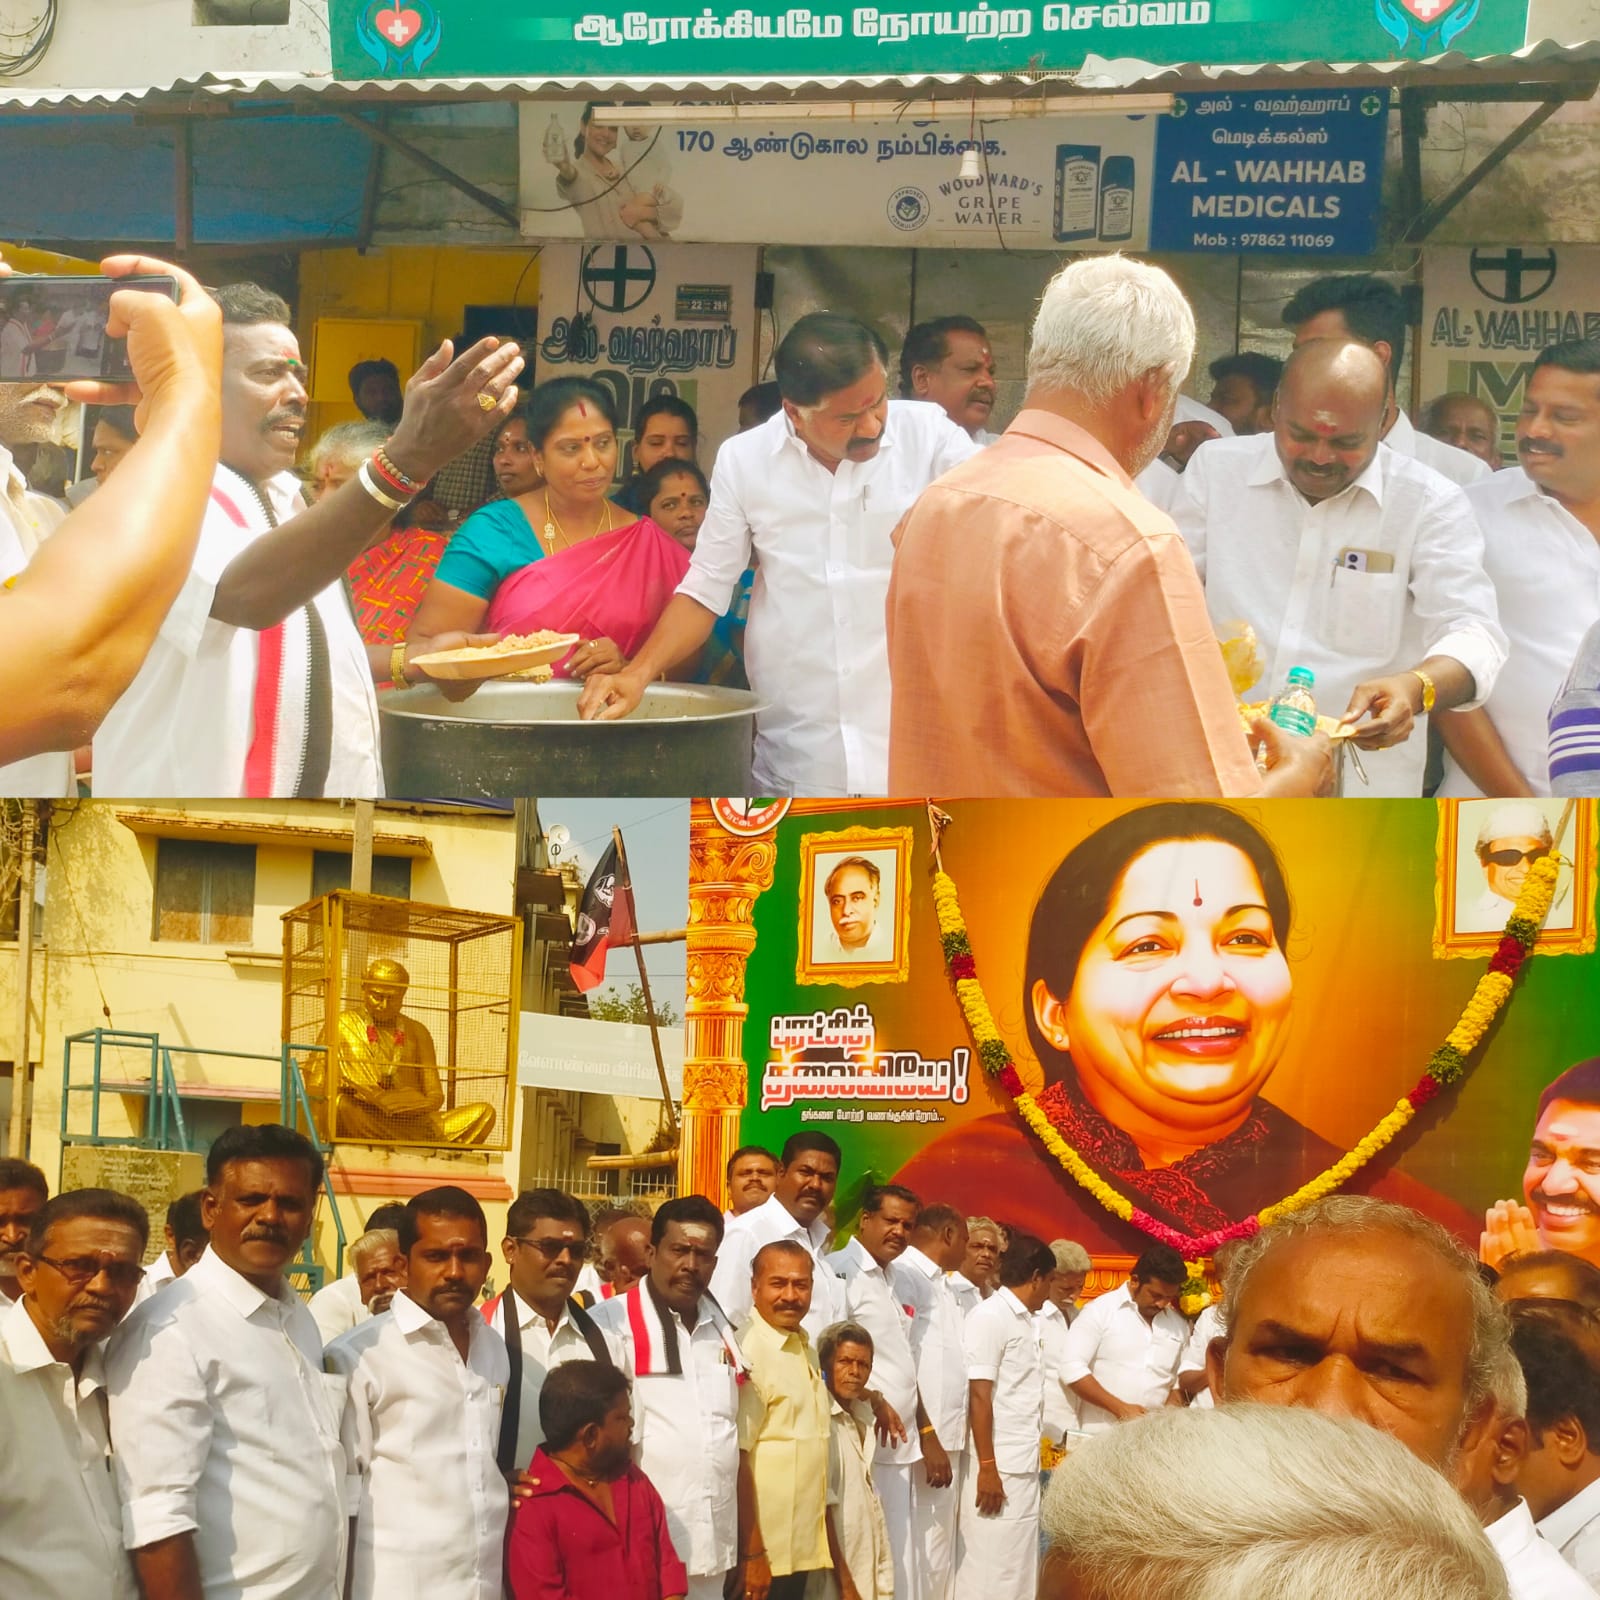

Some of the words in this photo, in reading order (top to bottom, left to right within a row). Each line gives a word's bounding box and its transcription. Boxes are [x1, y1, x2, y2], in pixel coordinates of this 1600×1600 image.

[574, 8, 842, 46] ஆரோக்கியமே
[853, 2, 1031, 46] நோயற்ற
[1195, 96, 1232, 115] அல்
[1254, 95, 1350, 117] வஹ்ஹாப்
[676, 130, 714, 152] 170
[723, 131, 868, 161] ஆண்டுகால
[1212, 127, 1328, 148] மெடிக்கல்ஸ்
[1171, 161, 1208, 183] AL
[1235, 160, 1366, 183] WAHHAB
[1192, 195, 1341, 218] MEDICALS
[955, 211, 1022, 225] WATER
[1193, 233, 1227, 246] Mob
[1241, 233, 1286, 247] 97862
[1290, 234, 1335, 247] 11069
